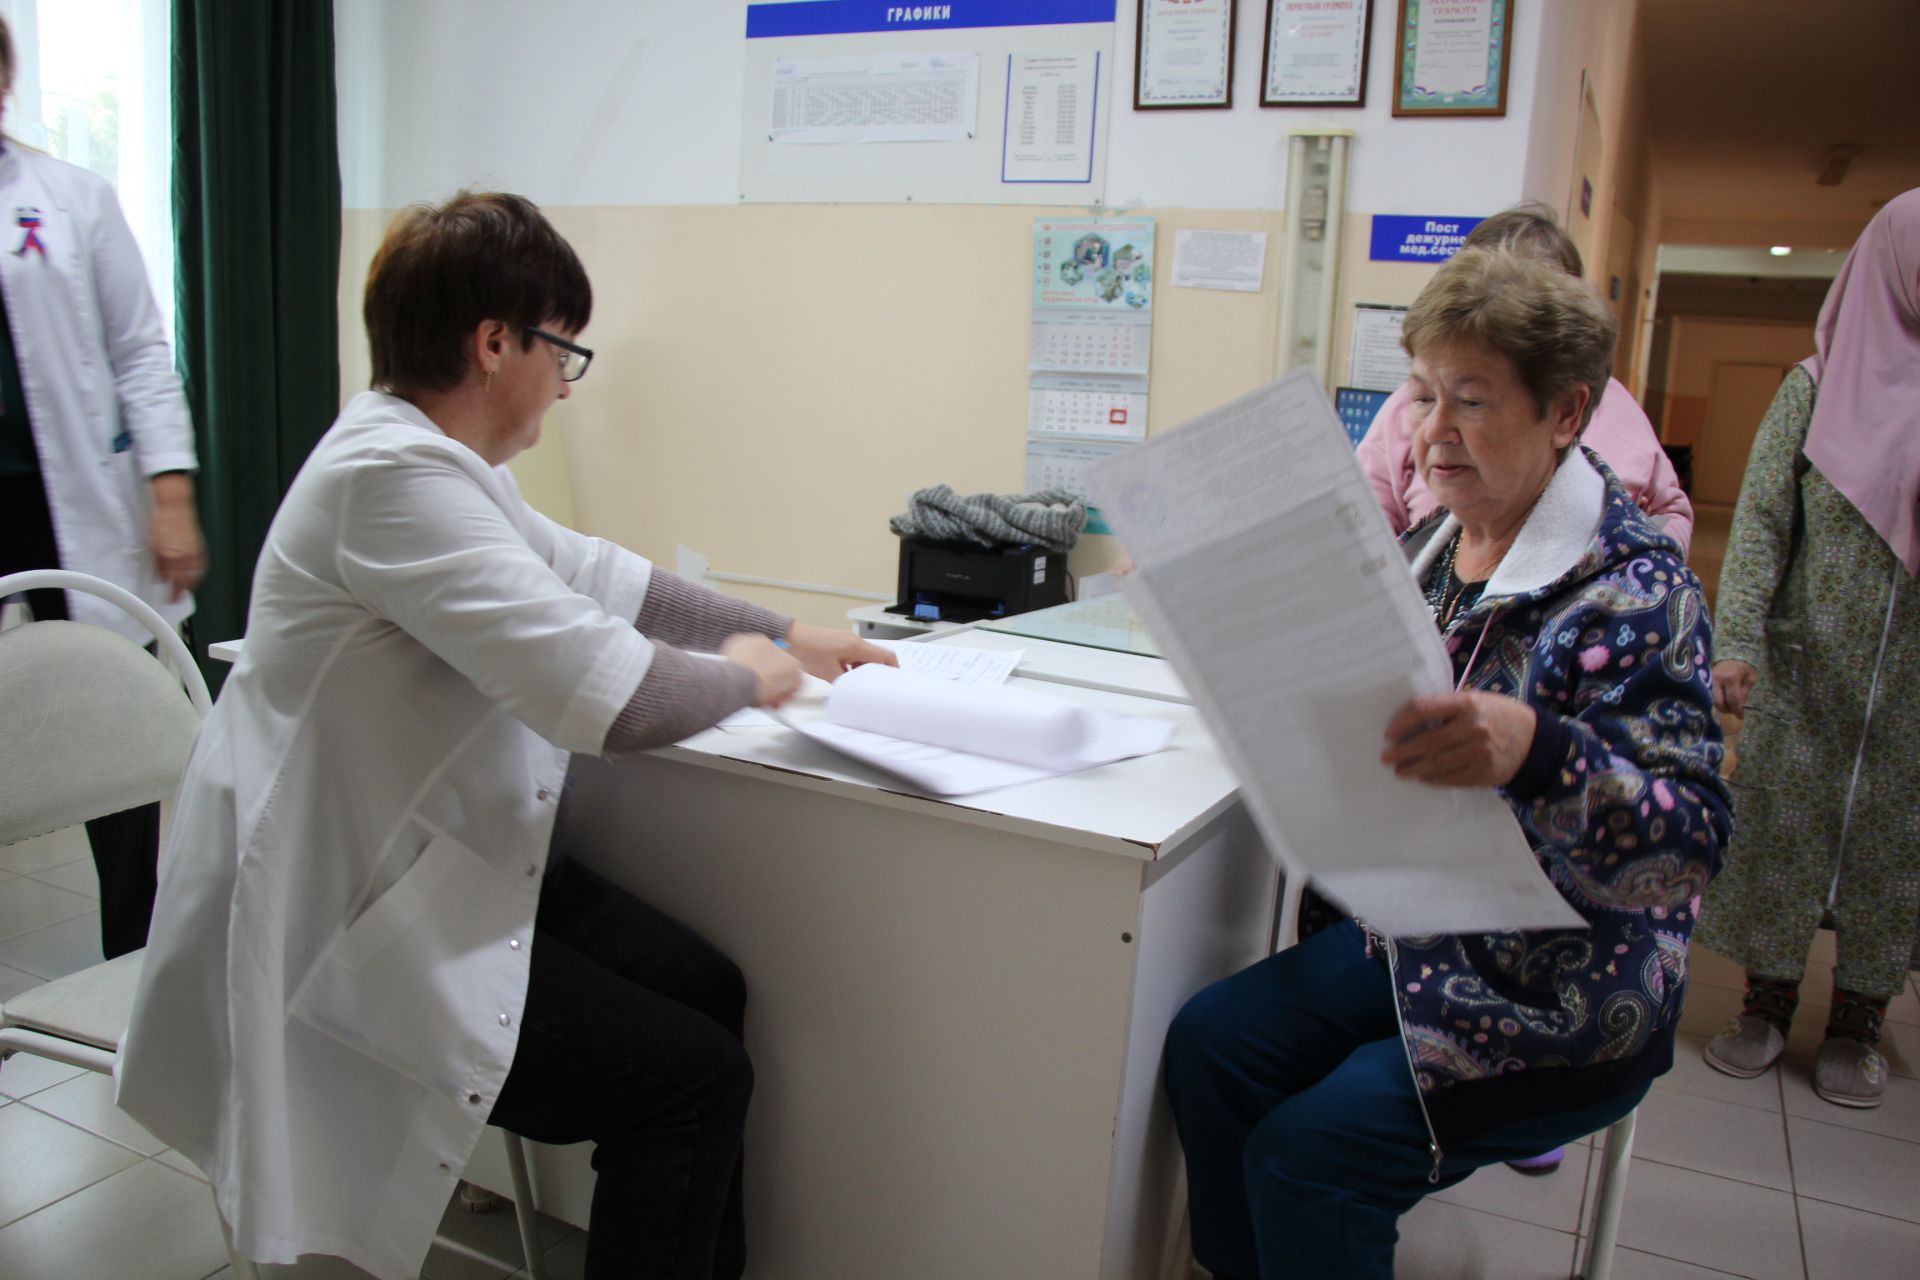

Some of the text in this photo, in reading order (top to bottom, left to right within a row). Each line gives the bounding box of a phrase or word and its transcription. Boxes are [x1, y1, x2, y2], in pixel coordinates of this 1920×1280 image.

[887, 5, 951, 22] ГРАФИКИ
[1432, 6, 1478, 15] ГРАМОТА
[1425, 220, 1460, 232] Пост
